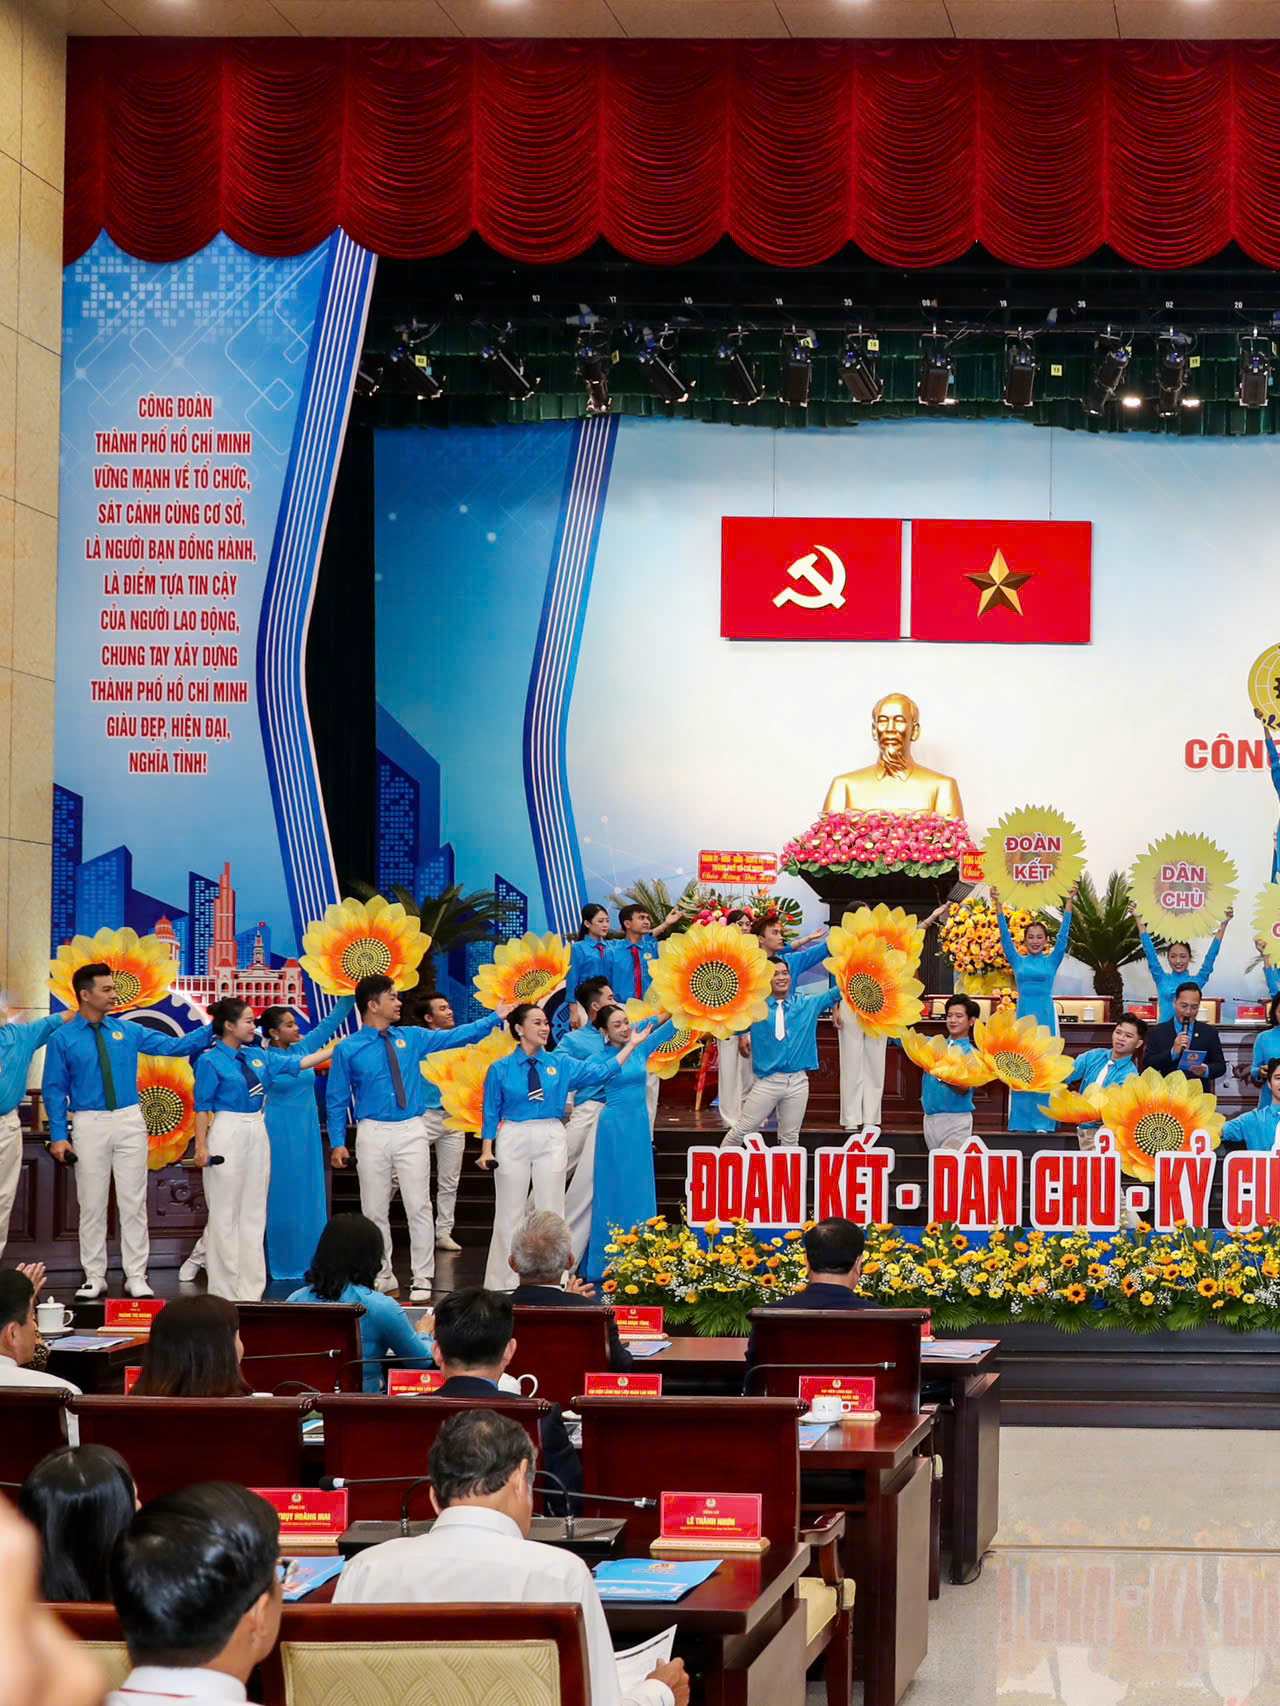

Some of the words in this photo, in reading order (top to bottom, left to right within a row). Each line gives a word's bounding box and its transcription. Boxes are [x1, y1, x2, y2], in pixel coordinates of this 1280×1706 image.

[140, 394, 174, 418] CÔNG
[178, 395, 212, 418] ĐOÀN
[96, 433, 138, 453] THÀNH
[142, 430, 167, 454] PHỐ
[171, 428, 188, 454] HỒ
[192, 432, 213, 454] CHÍ
[217, 433, 251, 454] MINH
[96, 465, 128, 488] VỮNG
[133, 469, 171, 493] MẠNH
[176, 466, 190, 489] VỀ
[194, 462, 210, 488] TỔ
[214, 466, 251, 489] CHỨC,
[99, 504, 122, 524] SÁT
[126, 504, 162, 524] CÁNH
[166, 504, 200, 525] CÙNG
[204, 504, 222, 525] CƠ
[225, 499, 245, 525] SỞ,
[87, 536, 102, 560] LÀ
[106, 536, 146, 560] NGƯỜI
[149, 539, 176, 564] BẠN
[179, 536, 214, 560] ĐỒNG
[218, 536, 256, 560] HÀNH,
[104, 573, 120, 595] LÀ
[124, 568, 157, 595] ĐIỂM
[160, 575, 184, 600] TỰA
[188, 576, 208, 595] TIN
[212, 572, 238, 600] CẬY
[102, 605, 127, 630] CỦA
[130, 609, 170, 631] NGƯỜI
[174, 611, 197, 632] LAO
[201, 608, 240, 635] ĐỘNG,
[102, 645, 146, 667] CHUNG
[150, 646, 171, 666] TAY
[175, 643, 200, 667] XÂY
[203, 646, 238, 671] DỰNG
[92, 681, 134, 702] THÀNH
[137, 677, 163, 702] PHỐ
[168, 678, 184, 702] HỒ
[188, 681, 210, 702] CHÍ
[214, 682, 248, 703] MINH
[107, 714, 138, 736] GIÀU
[142, 717, 168, 742] ĐẸP,
[172, 714, 202, 742] HIỆN
[206, 718, 231, 742] ĐẠI,
[130, 750, 169, 773] NGHĨA
[173, 753, 207, 773] TÌNH!
[1005, 836, 1061, 853] ĐOÀN
[1014, 858, 1052, 881] KẾT
[1161, 862, 1205, 882] DÂN
[1161, 888, 1204, 909] CHỦ
[692, 1141, 800, 1222] ĐOÀN
[820, 1135, 888, 1223] KẾT
[934, 1144, 1016, 1224] DÂN
[1036, 1136, 1115, 1225] CHỦ
[1160, 1137, 1210, 1226] KỶ
